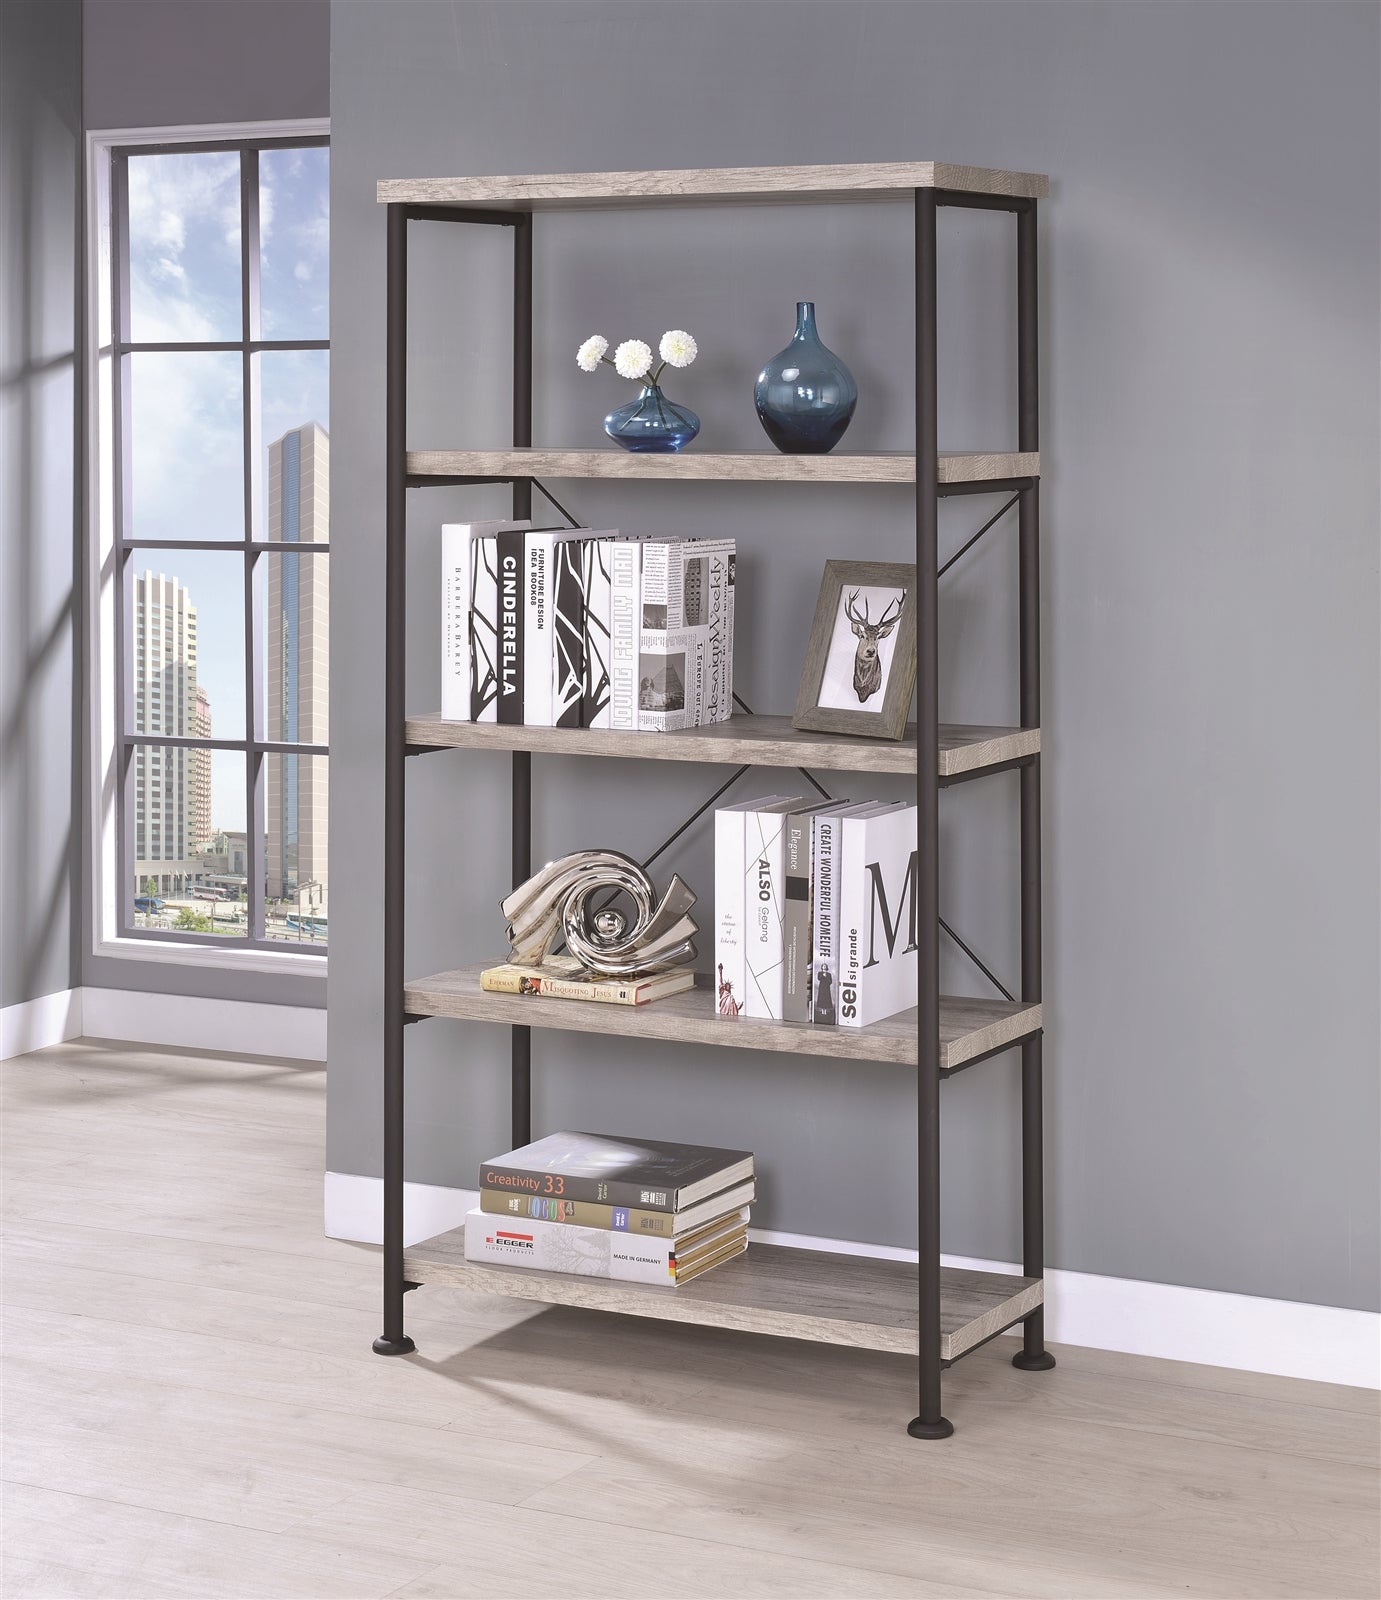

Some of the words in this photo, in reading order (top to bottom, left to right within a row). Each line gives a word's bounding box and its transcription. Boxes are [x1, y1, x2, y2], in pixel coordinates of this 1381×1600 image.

[537, 548, 545, 597] FURNITURE
[613, 548, 633, 588] MAN
[502, 556, 517, 696] CINDERELLA
[613, 596, 633, 661] FAMILY
[613, 668, 633, 728] LOVING
[788, 828, 801, 870] Elegance
[820, 824, 832, 855] CREATE
[758, 858, 771, 902] ALSO
[820, 858, 832, 912] WONDERFUL
[819, 914, 831, 958] HOMELIFE
[541, 980, 589, 996] MISQUOTING
[591, 987, 612, 999] JESUS
[838, 981, 857, 1019] sei
[486, 1172, 541, 1192] Creativity
[543, 1175, 565, 1195] 33
[496, 1239, 534, 1249] EGGER
[613, 1253, 629, 1261] MADE
[636, 1257, 661, 1265] GERMANY
